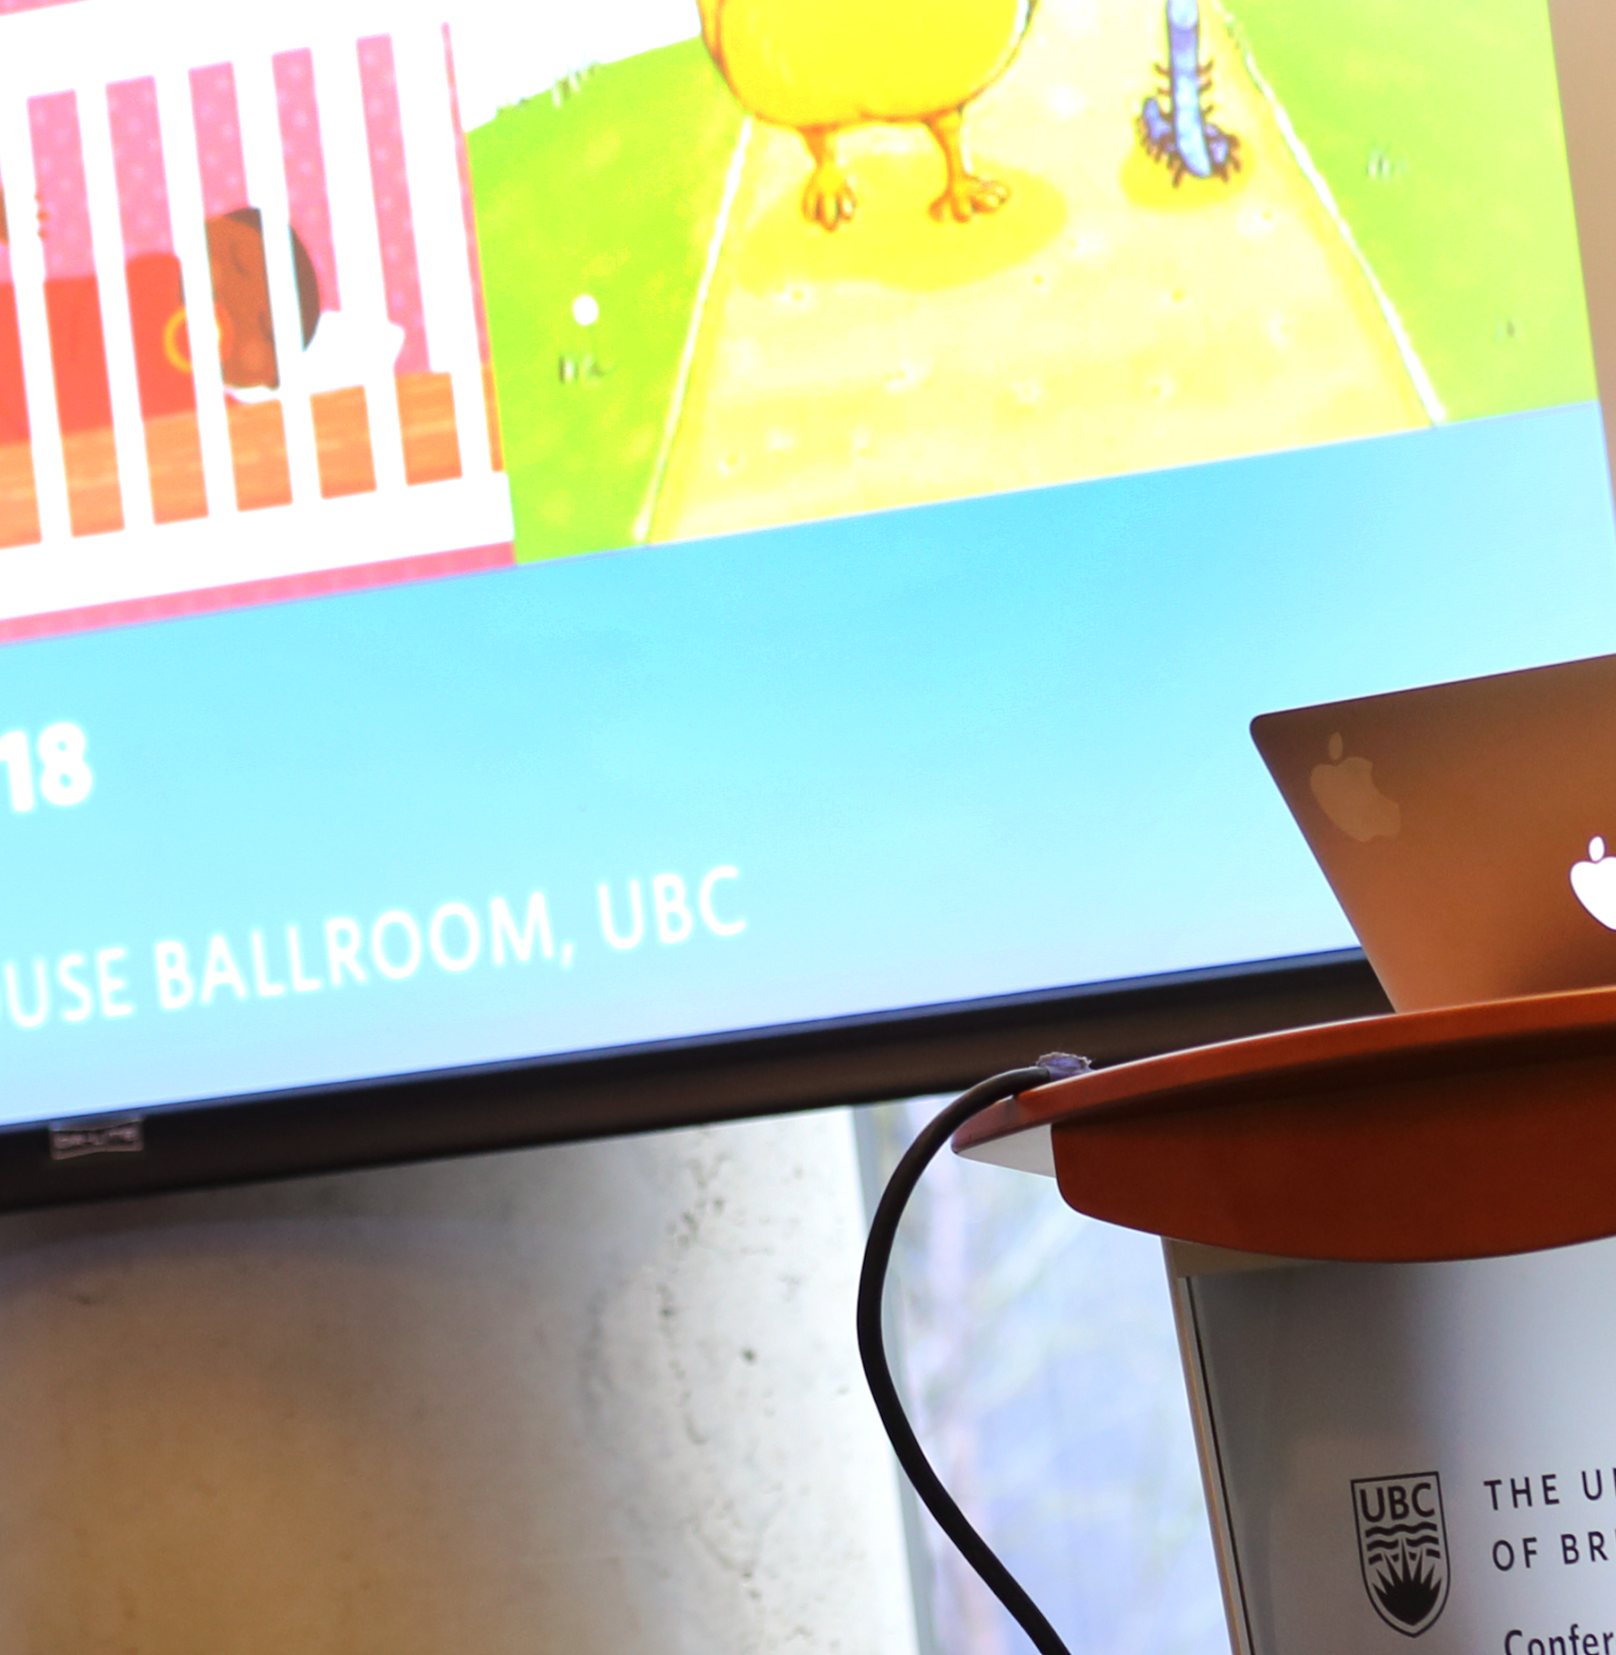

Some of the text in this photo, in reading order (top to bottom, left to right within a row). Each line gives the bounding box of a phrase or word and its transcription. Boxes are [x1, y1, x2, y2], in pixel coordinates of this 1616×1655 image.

[153, 889, 576, 1012] BALLROOM,
[596, 863, 748, 952] UBC
[1359, 1482, 1436, 1523] UBC
[1483, 1473, 1561, 1511] THE
[1492, 1536, 1539, 1572] OF
